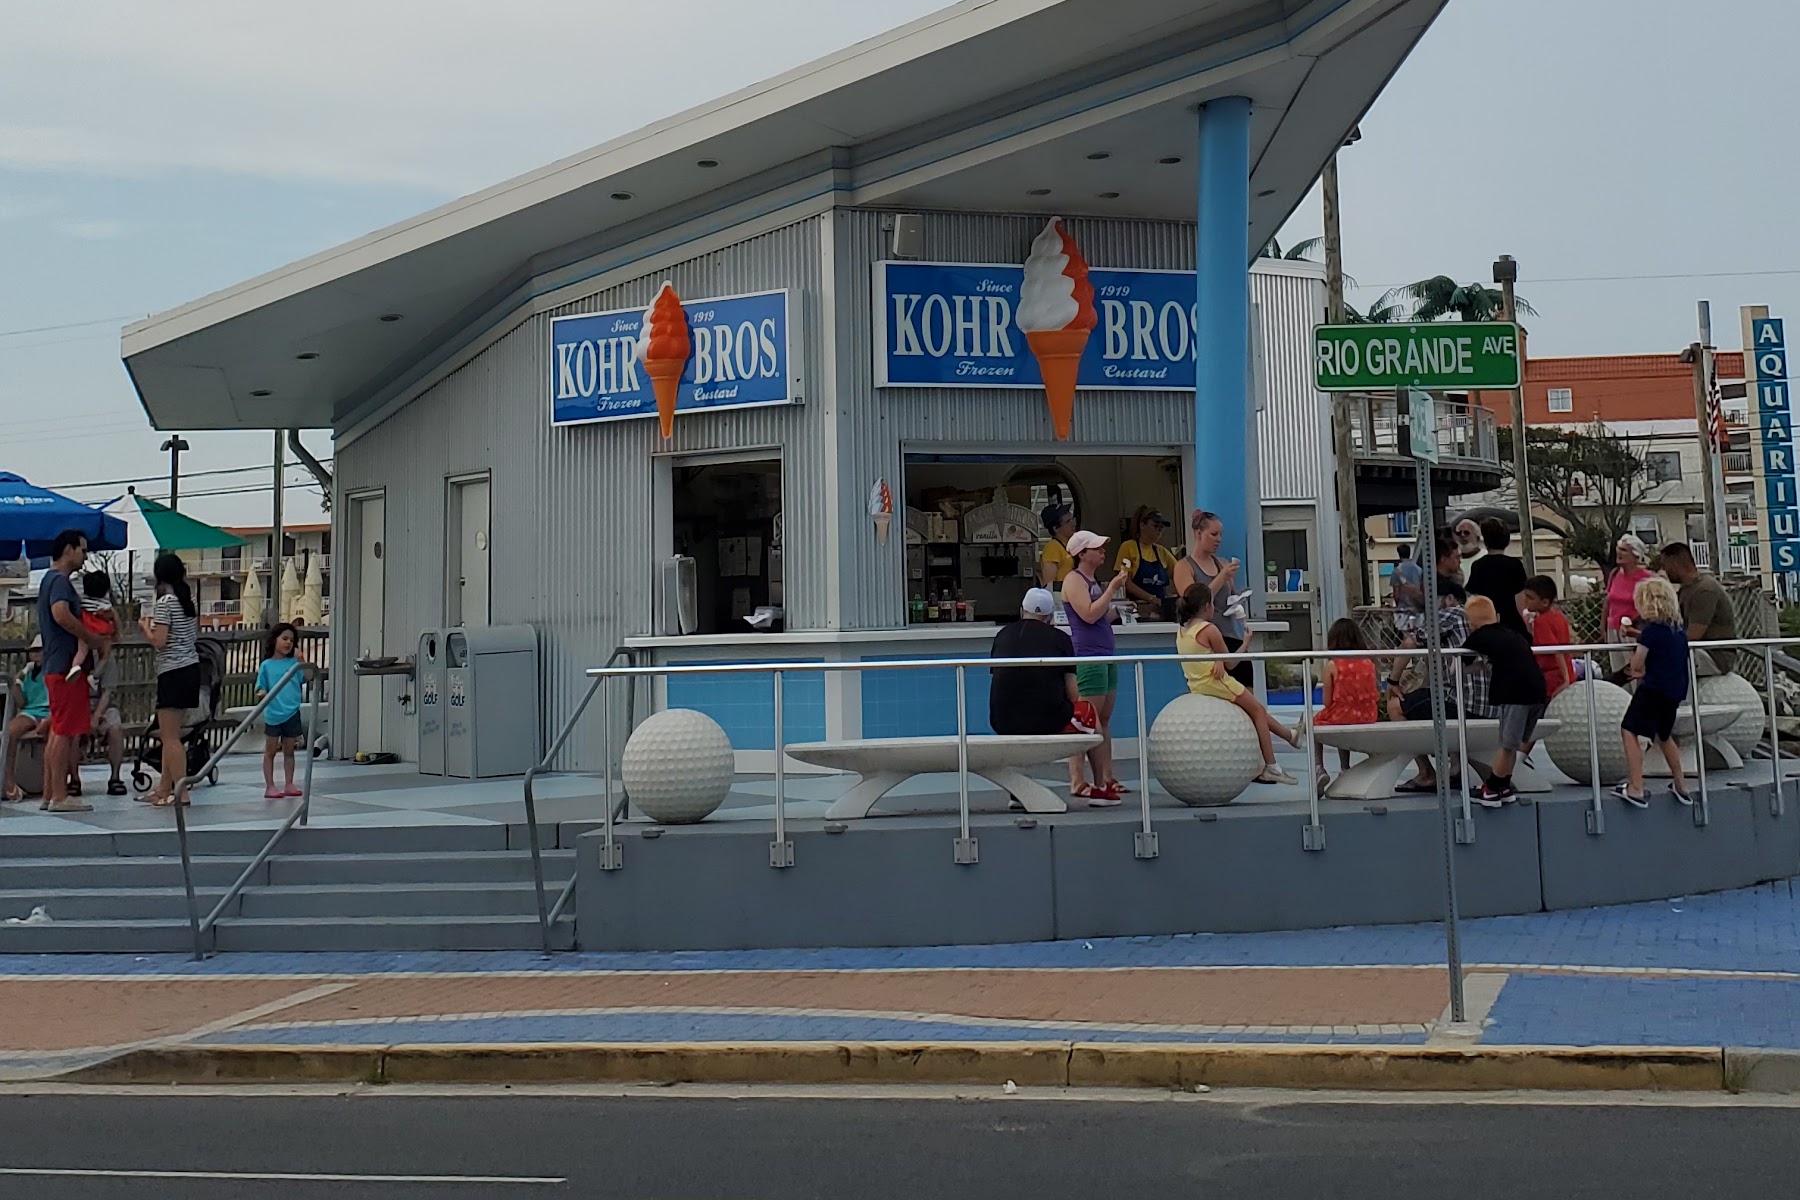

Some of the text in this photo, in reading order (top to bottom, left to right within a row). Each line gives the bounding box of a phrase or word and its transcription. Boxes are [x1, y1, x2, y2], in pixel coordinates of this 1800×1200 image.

[975, 279, 1130, 297] Since 1919
[611, 310, 715, 333] Since 1919
[892, 293, 1197, 363] KOHR BRO
[557, 336, 640, 400] KOHR
[955, 361, 1168, 379] Frozen Custard
[1317, 336, 1514, 376] RIO GRANDE AVE
[597, 385, 738, 412] Frozen Custard
[1759, 323, 1795, 567] AQUARIUS
